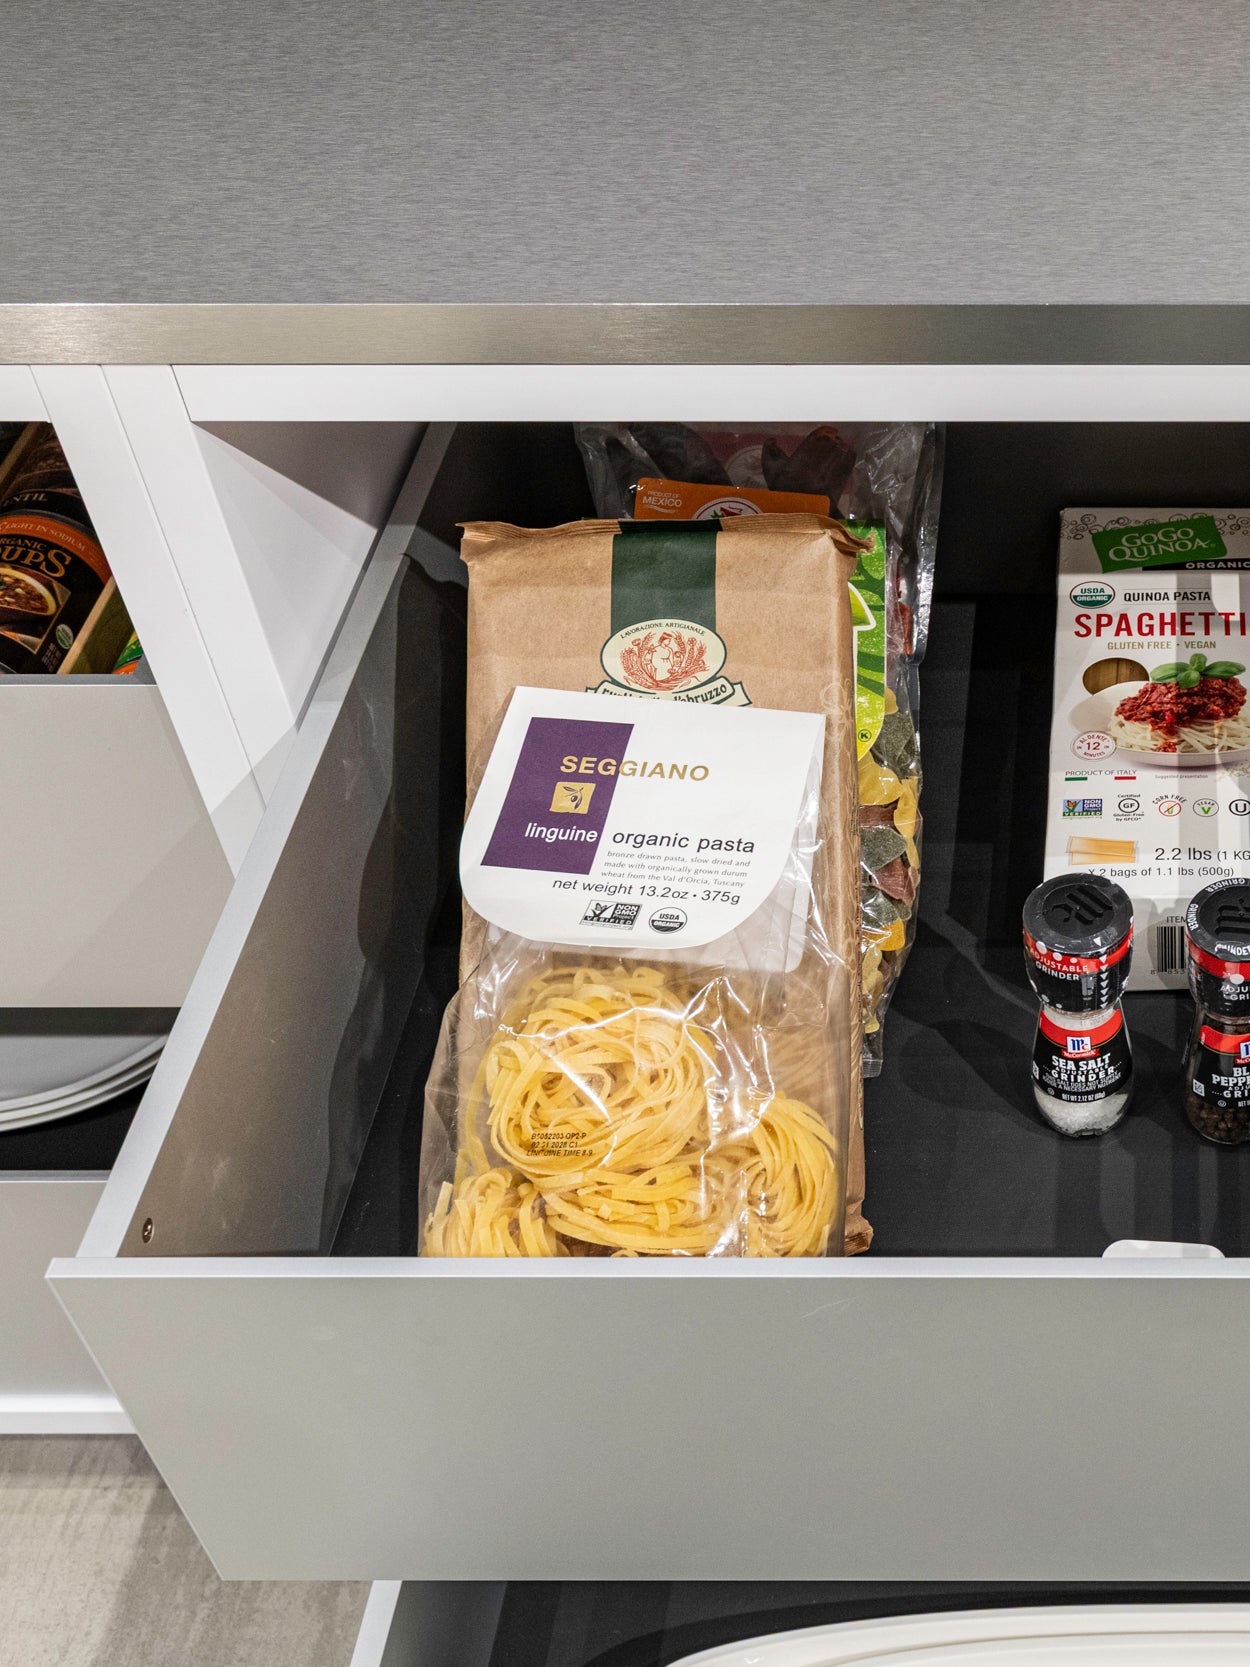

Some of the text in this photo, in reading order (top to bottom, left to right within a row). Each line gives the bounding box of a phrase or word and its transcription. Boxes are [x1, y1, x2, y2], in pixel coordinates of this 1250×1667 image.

[642, 496, 682, 508] MEXICO
[647, 490, 670, 498] PRODUCT
[36, 525, 48, 533] IN
[49, 529, 87, 551] SODIUM
[0, 544, 72, 578] UPS
[1080, 587, 1105, 595] USDA
[1123, 591, 1211, 602] QUINOA PASTA
[620, 622, 705, 639] LAVORAZIONE ARTIGIANALE
[1074, 612, 1247, 638] SPAGHETTI
[1107, 641, 1216, 650] GLUTEN FREE VEGAN
[1086, 741, 1101, 751] 12
[560, 755, 710, 782] SEGGIANO
[1152, 795, 1188, 805] CORN FREE
[525, 822, 598, 843] linguine
[612, 832, 755, 853] organic pasta
[607, 850, 751, 868] bronze drawn pasta, slow dried and
[1155, 847, 1182, 861] 2.2
[1188, 847, 1212, 861] lbs
[1217, 850, 1228, 862] (1
[604, 860, 748, 878] made with organically grown durum
[1099, 868, 1107, 877] 2
[1110, 867, 1138, 879] bags
[1141, 867, 1151, 876] of
[1157, 867, 1172, 876] 1.1
[1178, 867, 1194, 876] lbs
[1198, 866, 1235, 878] (500g)
[601, 870, 625, 879] wheat
[627, 871, 646, 880] from
[648, 873, 661, 881] the
[663, 874, 675, 882] Val
[713, 878, 745, 888] Tuscany
[1205, 877, 1247, 893] GRINDER
[552, 880, 741, 905] net weight 13.2oz 375g
[586, 916, 632, 926] VERIFIED
[659, 913, 680, 921] USDA
[1187, 903, 1199, 931] GRINDER
[1029, 948, 1089, 973] ADJUSTABLE
[1035, 961, 1080, 981] GRINDER
[1063, 1049, 1097, 1058] McCormick
[1052, 1055, 1077, 1071] SEA
[1079, 1053, 1111, 1071] SALT
[1055, 1064, 1109, 1075] ADJUSTABLE
[1051, 1066, 1114, 1082] GRINDER
[563, 1149, 581, 1157] TIME
